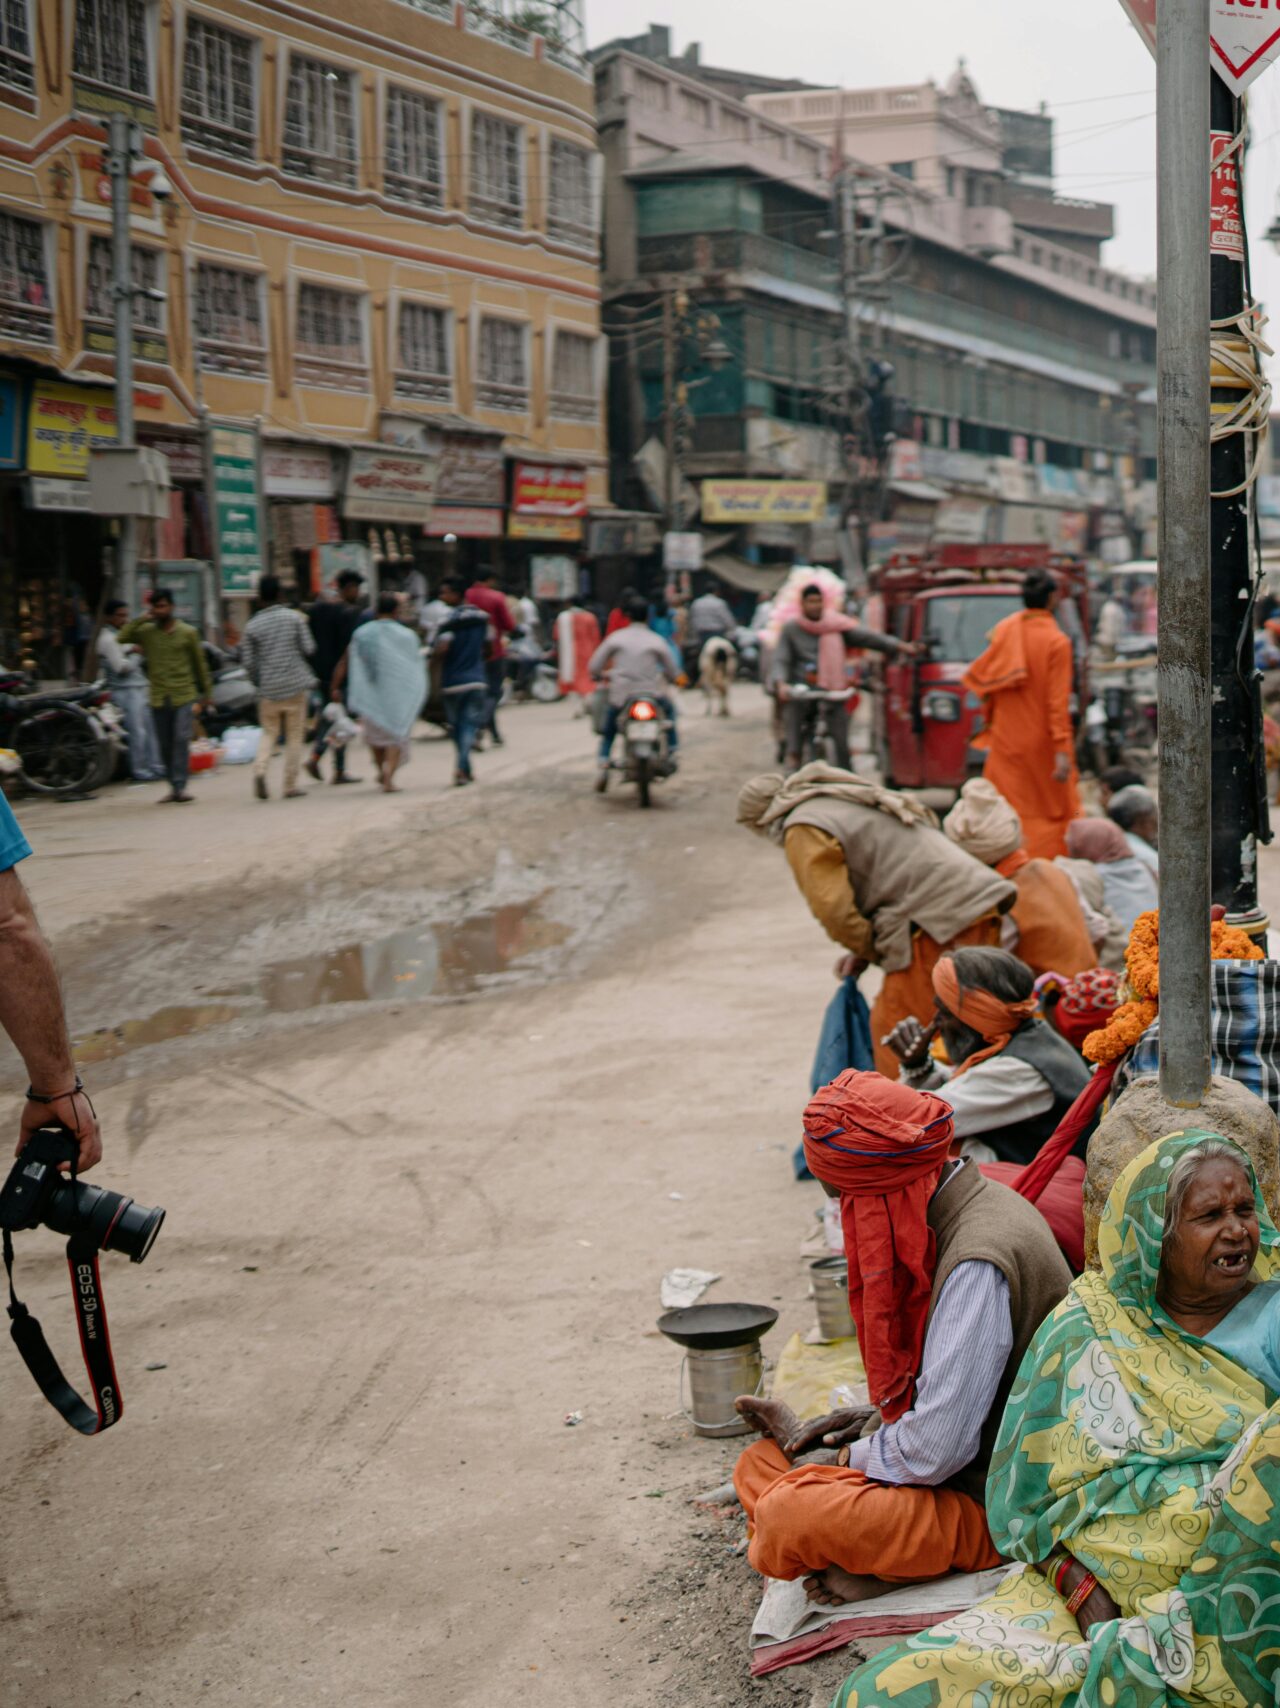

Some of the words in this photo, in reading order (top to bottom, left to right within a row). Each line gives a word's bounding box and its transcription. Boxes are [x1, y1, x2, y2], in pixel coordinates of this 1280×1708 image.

[77, 1264, 95, 1295] EOS
[82, 1297, 98, 1312] 5D
[100, 1386, 117, 1426] Canon
